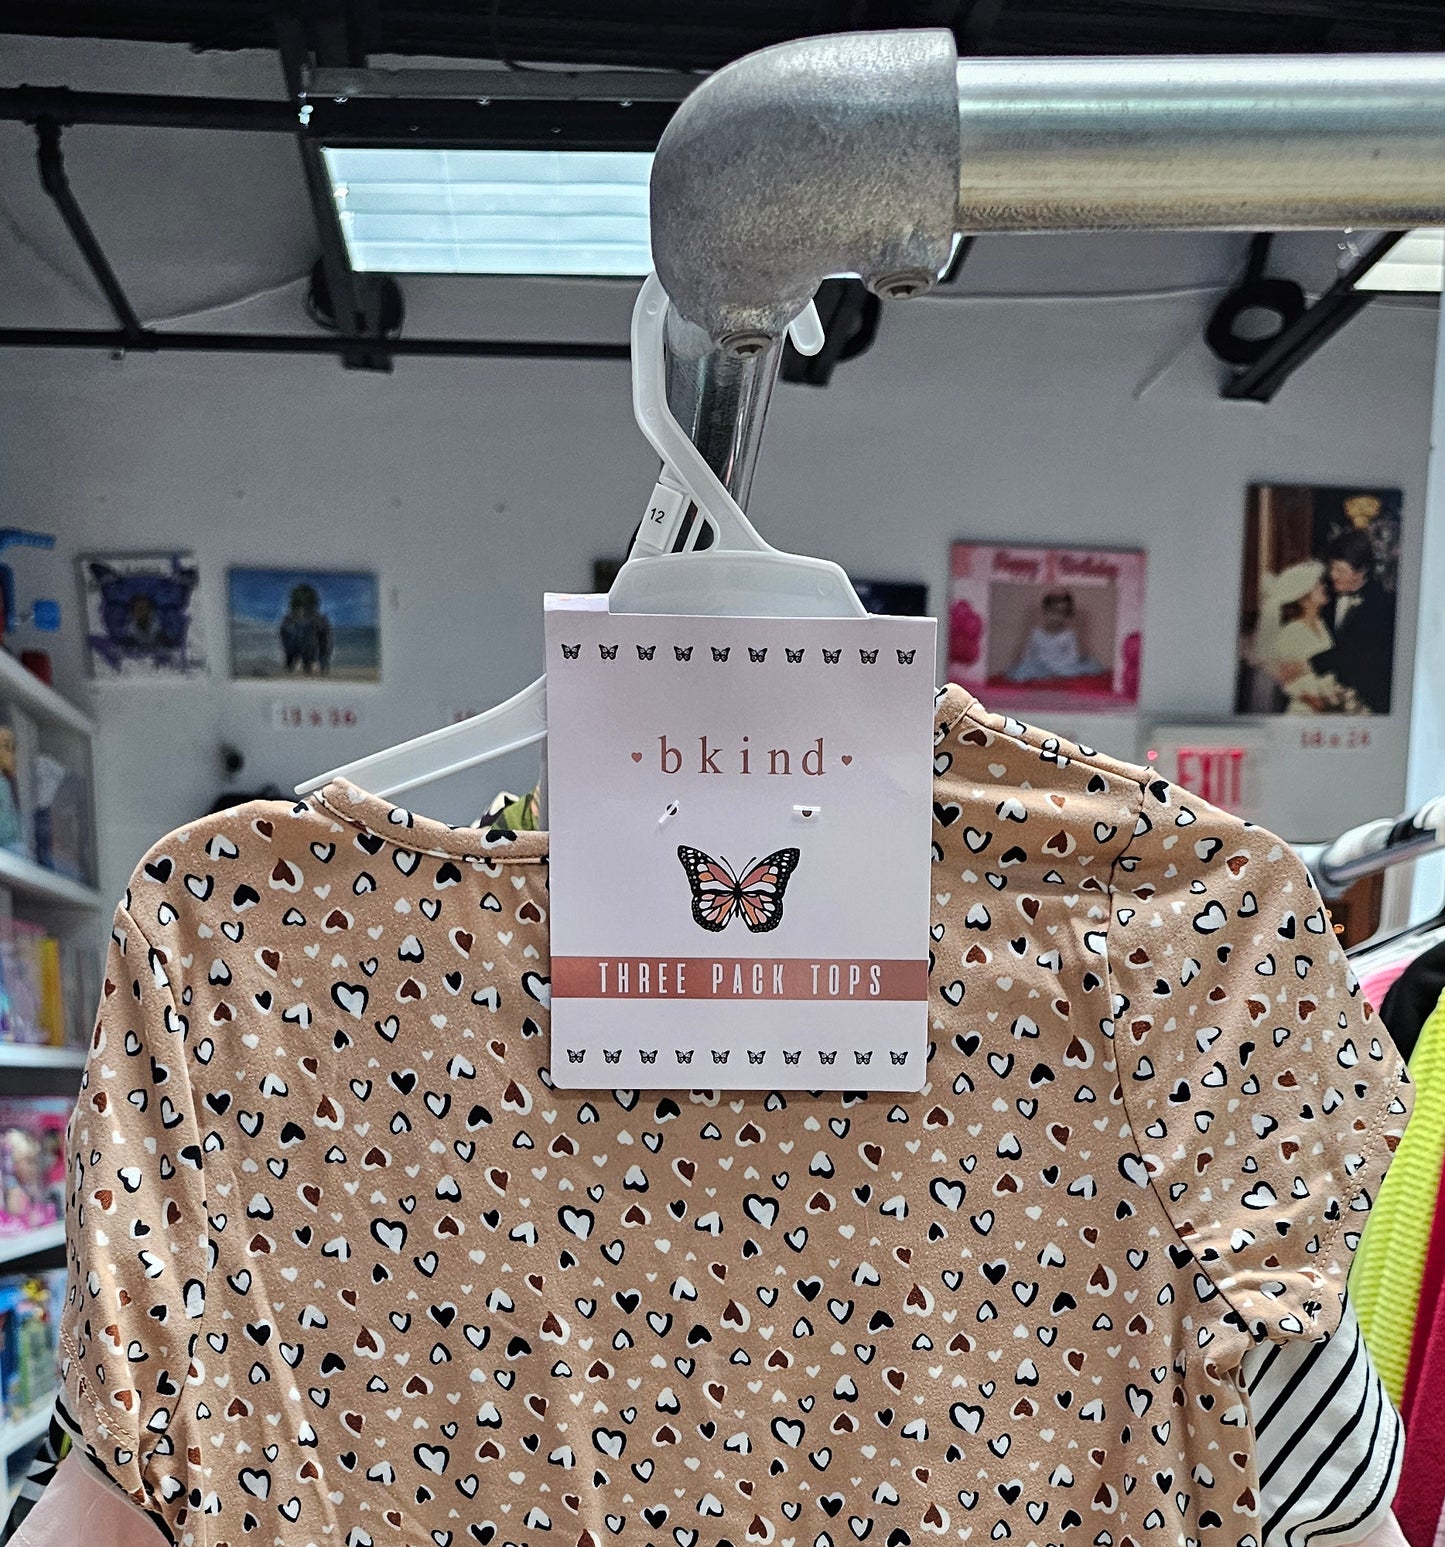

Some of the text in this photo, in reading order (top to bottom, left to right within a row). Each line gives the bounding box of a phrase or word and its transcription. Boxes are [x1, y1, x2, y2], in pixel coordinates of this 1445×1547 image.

[650, 507, 665, 524] 12
[657, 735, 826, 776] bkind
[1178, 748, 1242, 806] EXIT
[599, 962, 881, 996] THREE PACK TOPS
